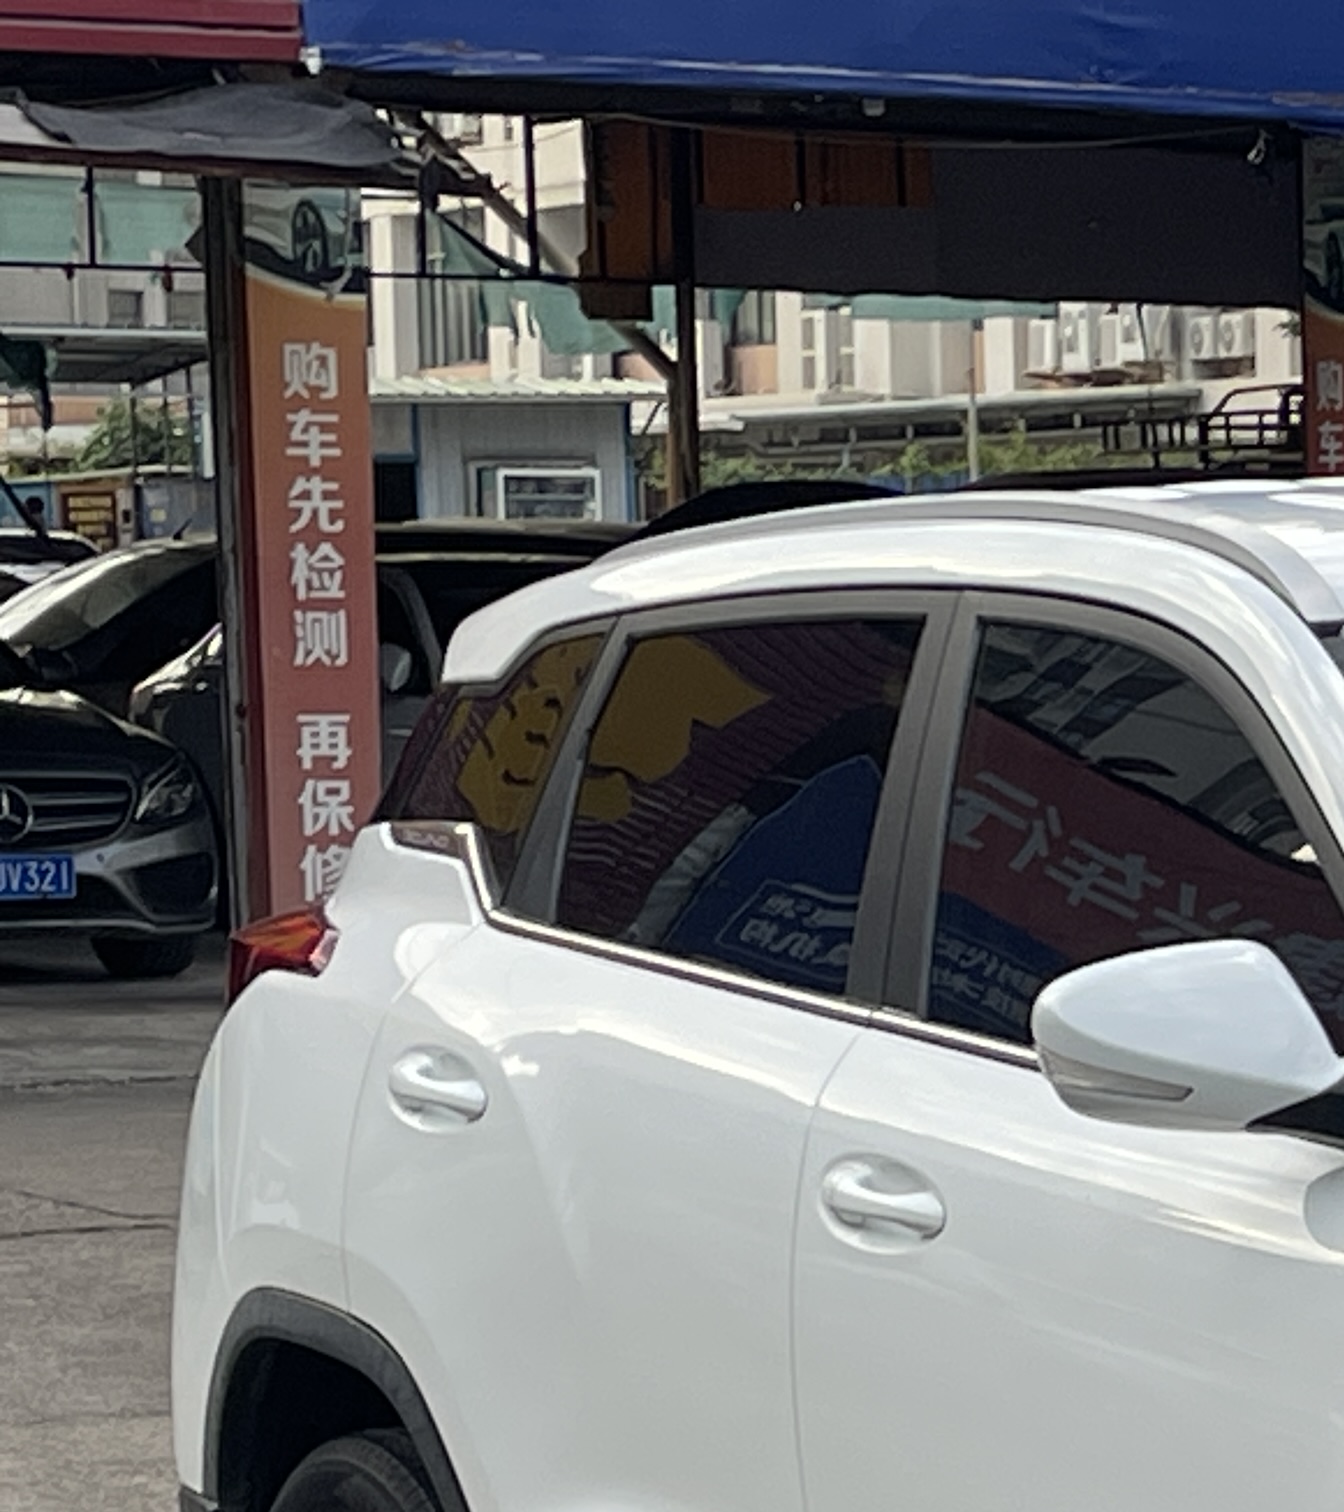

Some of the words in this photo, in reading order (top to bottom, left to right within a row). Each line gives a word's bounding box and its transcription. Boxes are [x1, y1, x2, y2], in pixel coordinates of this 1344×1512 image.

[281, 341, 348, 668] 购车先检测
[295, 712, 356, 902] 再保修
